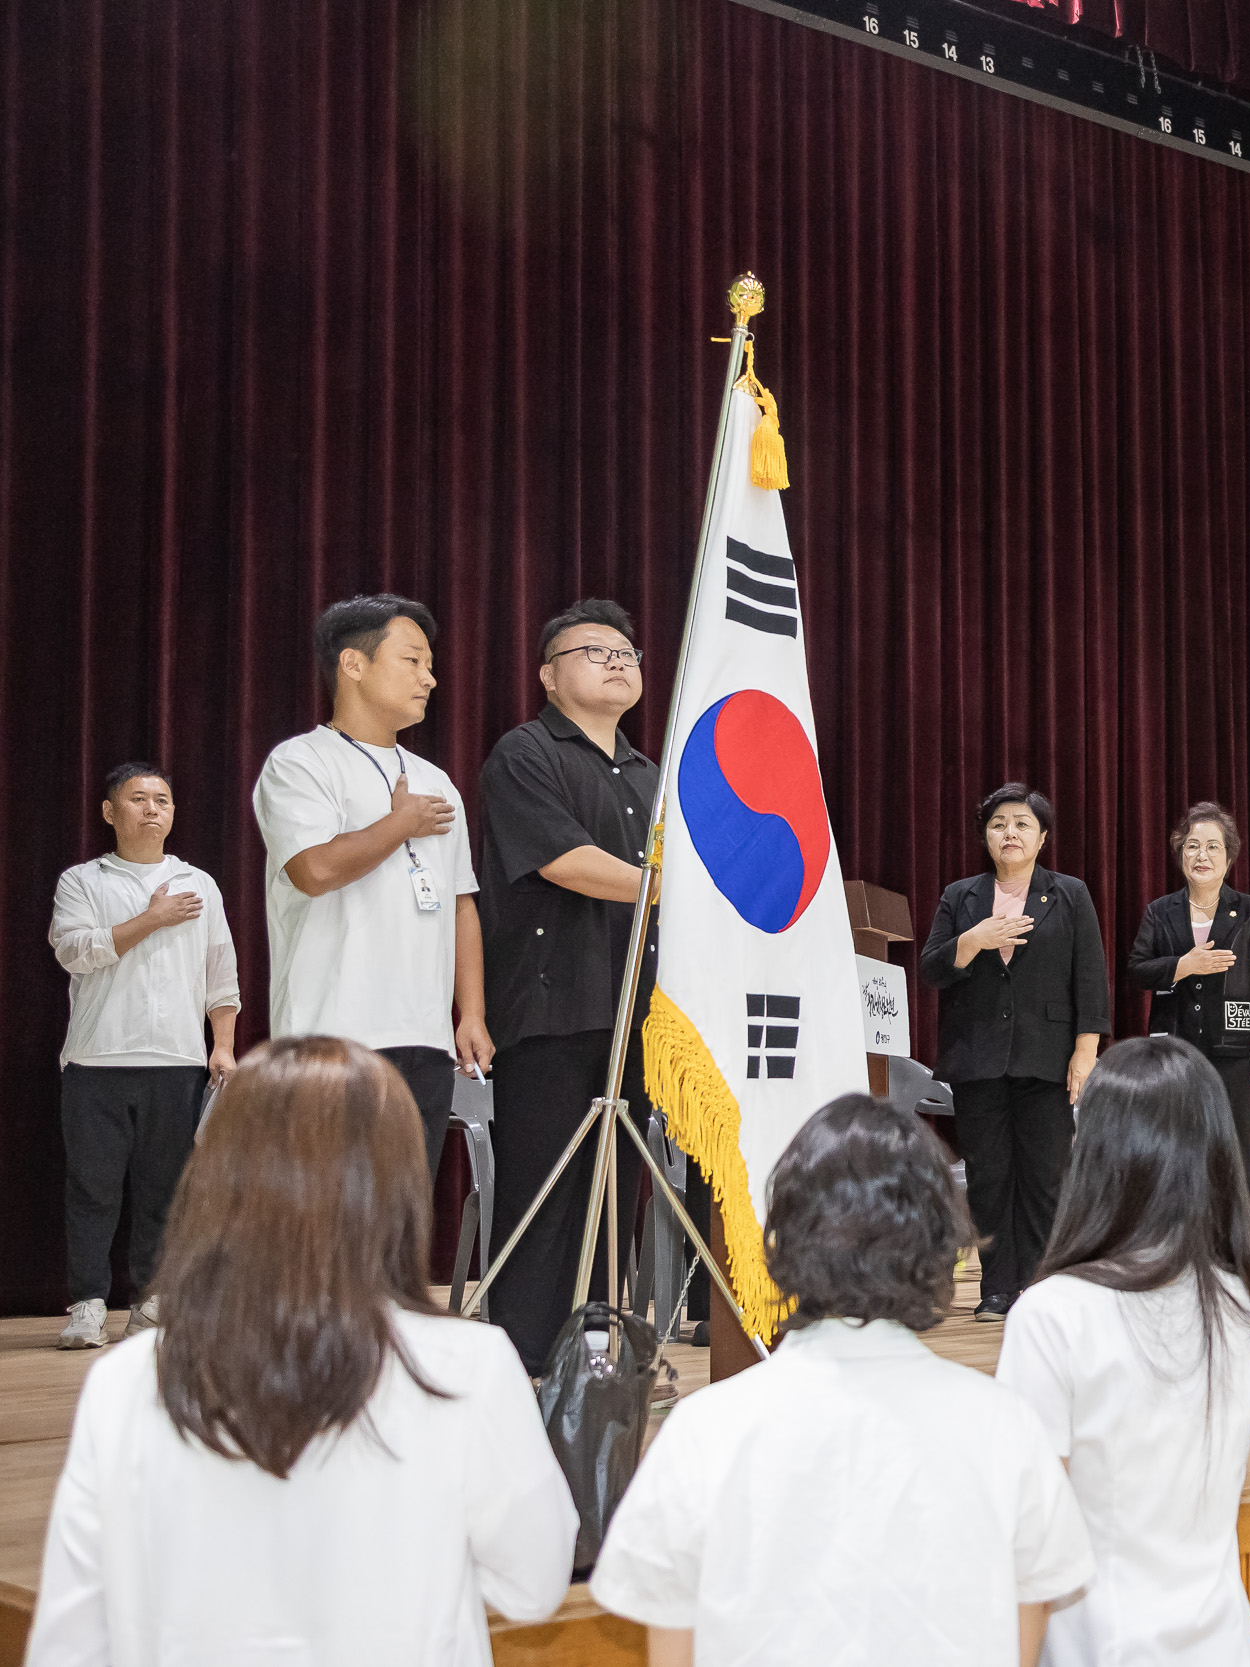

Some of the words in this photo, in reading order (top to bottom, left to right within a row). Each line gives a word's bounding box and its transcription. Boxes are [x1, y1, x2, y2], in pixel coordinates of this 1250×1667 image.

[862, 15, 879, 35] 16
[903, 29, 919, 49] 15
[941, 42, 958, 62] 14
[979, 55, 995, 74] 13
[1158, 116, 1172, 134] 16
[1192, 128, 1206, 145] 15
[1228, 140, 1242, 158] 14
